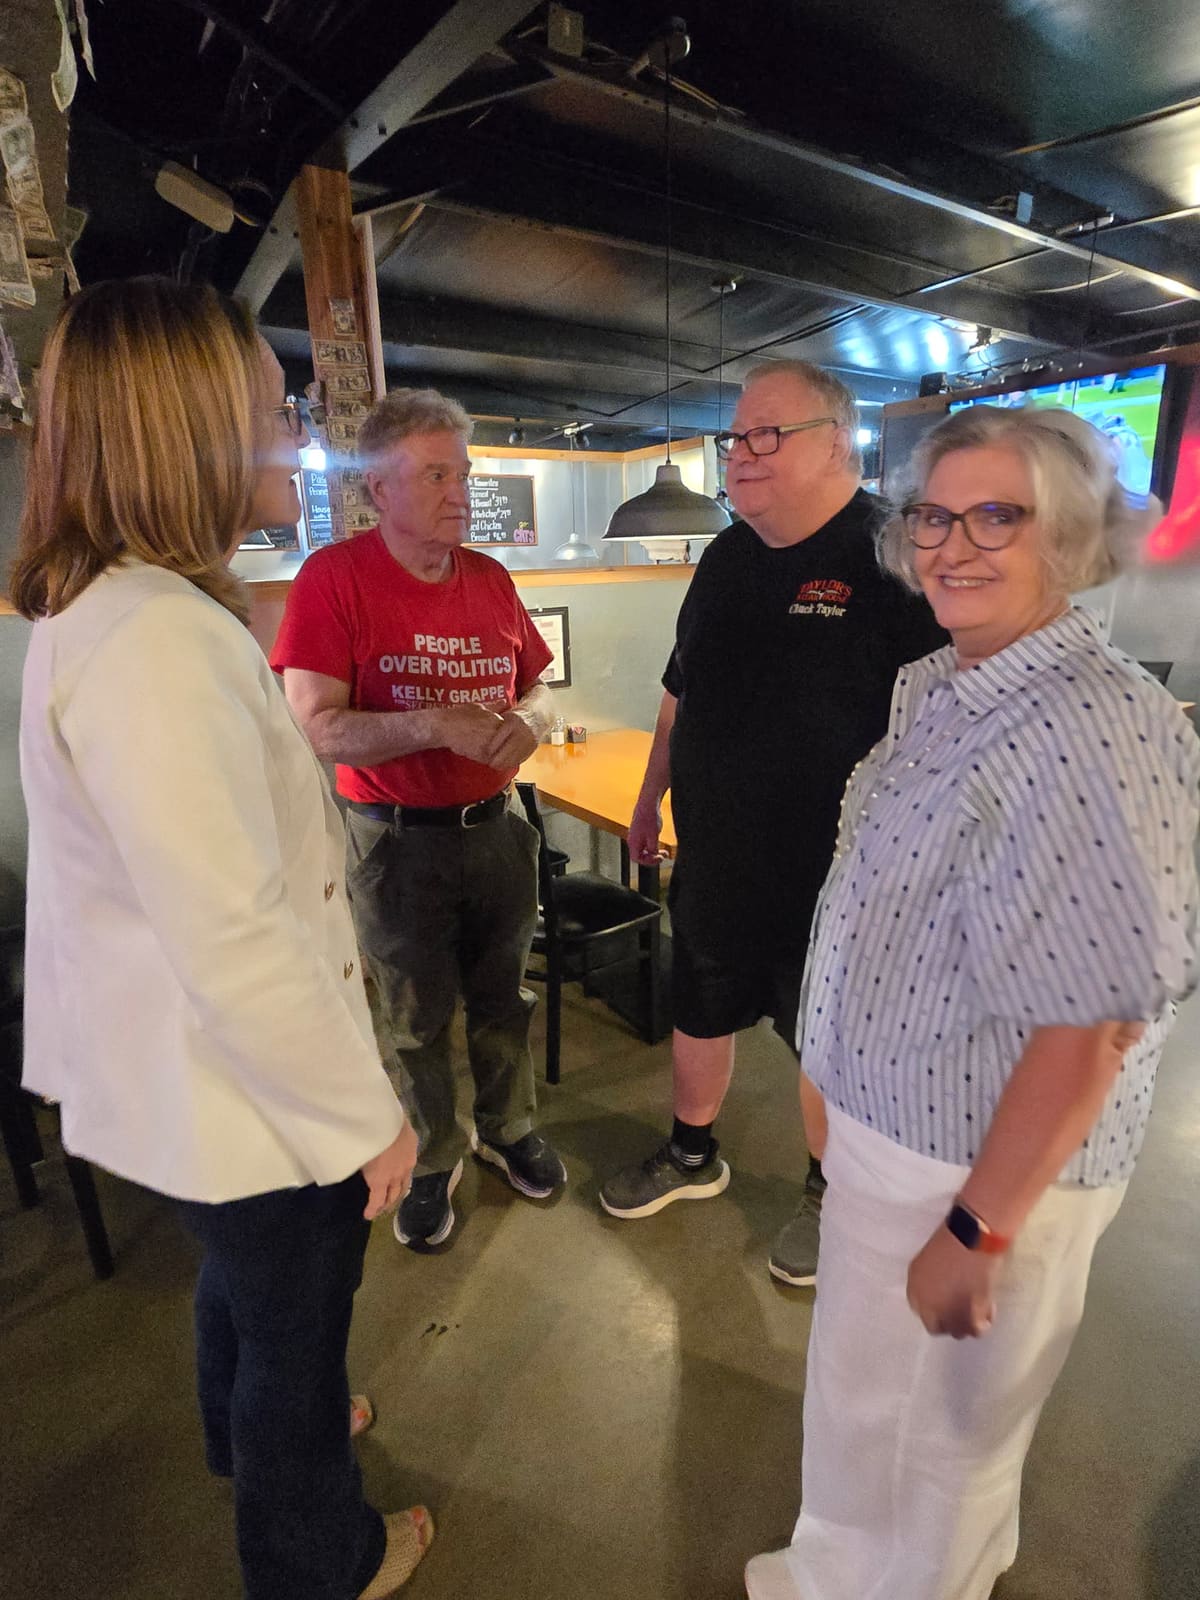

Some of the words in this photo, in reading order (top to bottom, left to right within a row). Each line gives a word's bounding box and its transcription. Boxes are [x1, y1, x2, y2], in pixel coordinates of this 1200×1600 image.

[816, 602, 847, 617] Taylor
[414, 633, 482, 656] PEOPLE
[379, 654, 433, 675] OVER
[437, 656, 512, 679] POLITICS
[391, 685, 444, 702] KELLY
[449, 684, 505, 704] GRAPPE
